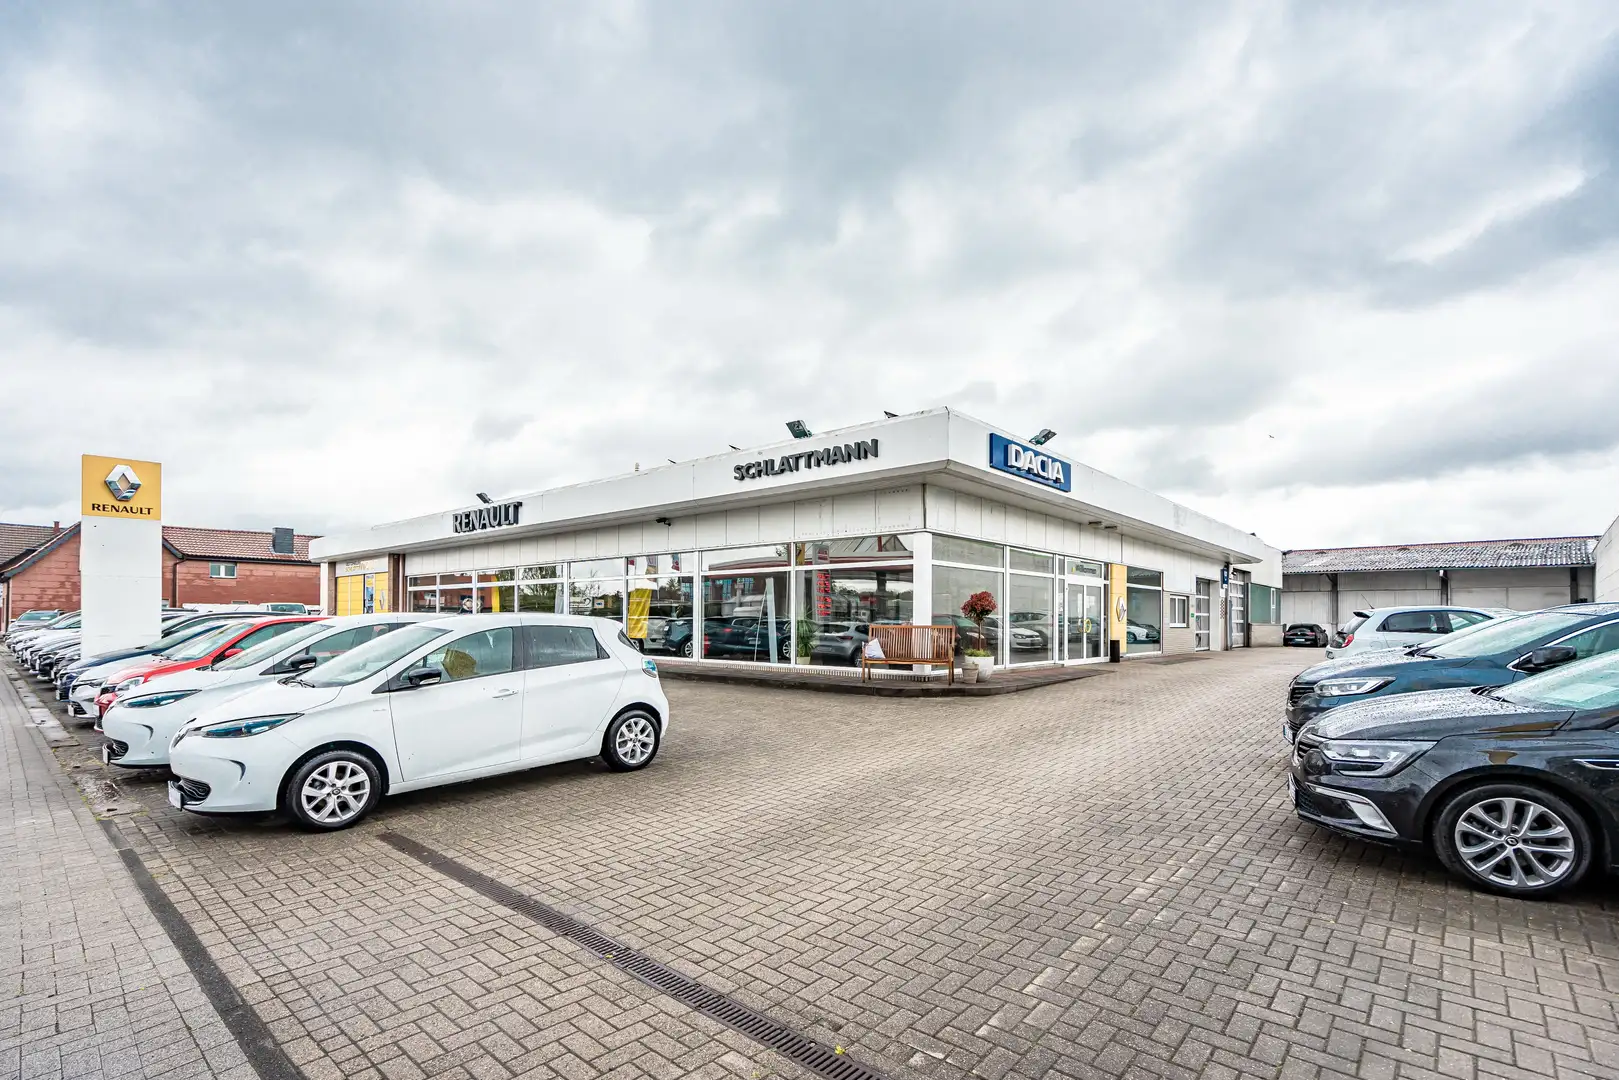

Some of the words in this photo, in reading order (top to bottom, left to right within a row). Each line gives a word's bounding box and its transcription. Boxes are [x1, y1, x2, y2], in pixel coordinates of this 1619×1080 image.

[733, 438, 879, 481] SCHLATTMANN
[1007, 444, 1064, 483] DACIA
[91, 503, 153, 515] RENAULT
[452, 501, 523, 533] RENAULT
